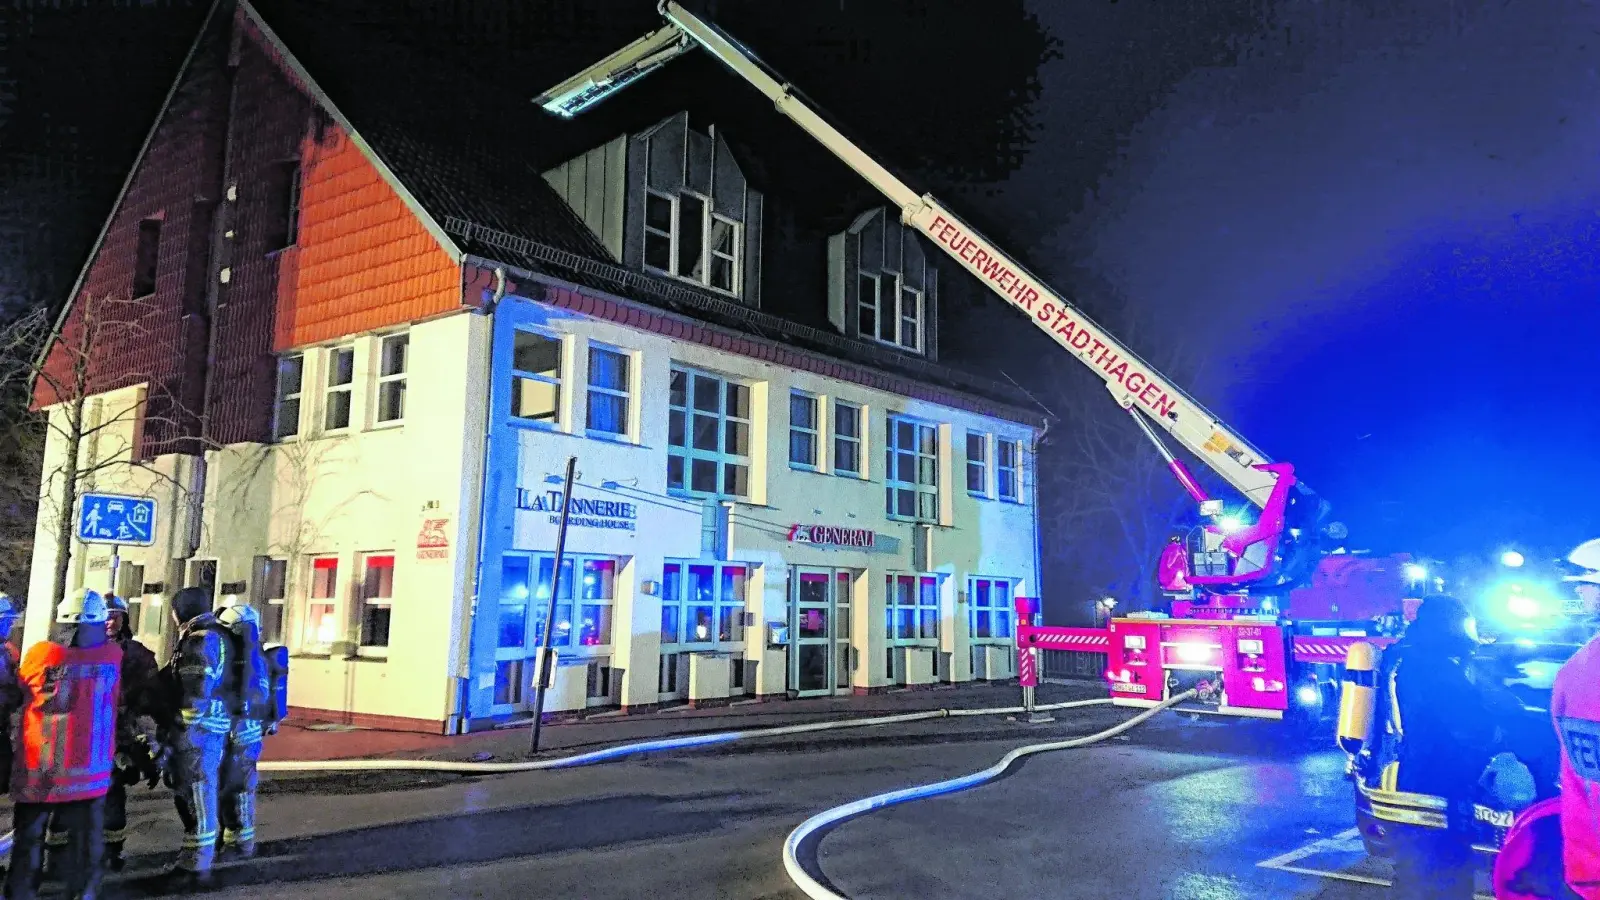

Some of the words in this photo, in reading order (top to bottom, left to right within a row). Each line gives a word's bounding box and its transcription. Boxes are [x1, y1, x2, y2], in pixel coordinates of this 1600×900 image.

[929, 216, 1038, 310] FEUERWEHR
[1037, 302, 1177, 417] STADTHAGEN
[516, 487, 544, 511] LA
[547, 490, 635, 519] TNNERIE
[549, 516, 599, 527] BORDING
[813, 526, 875, 547] GENERALI
[1567, 730, 1600, 769] FE
